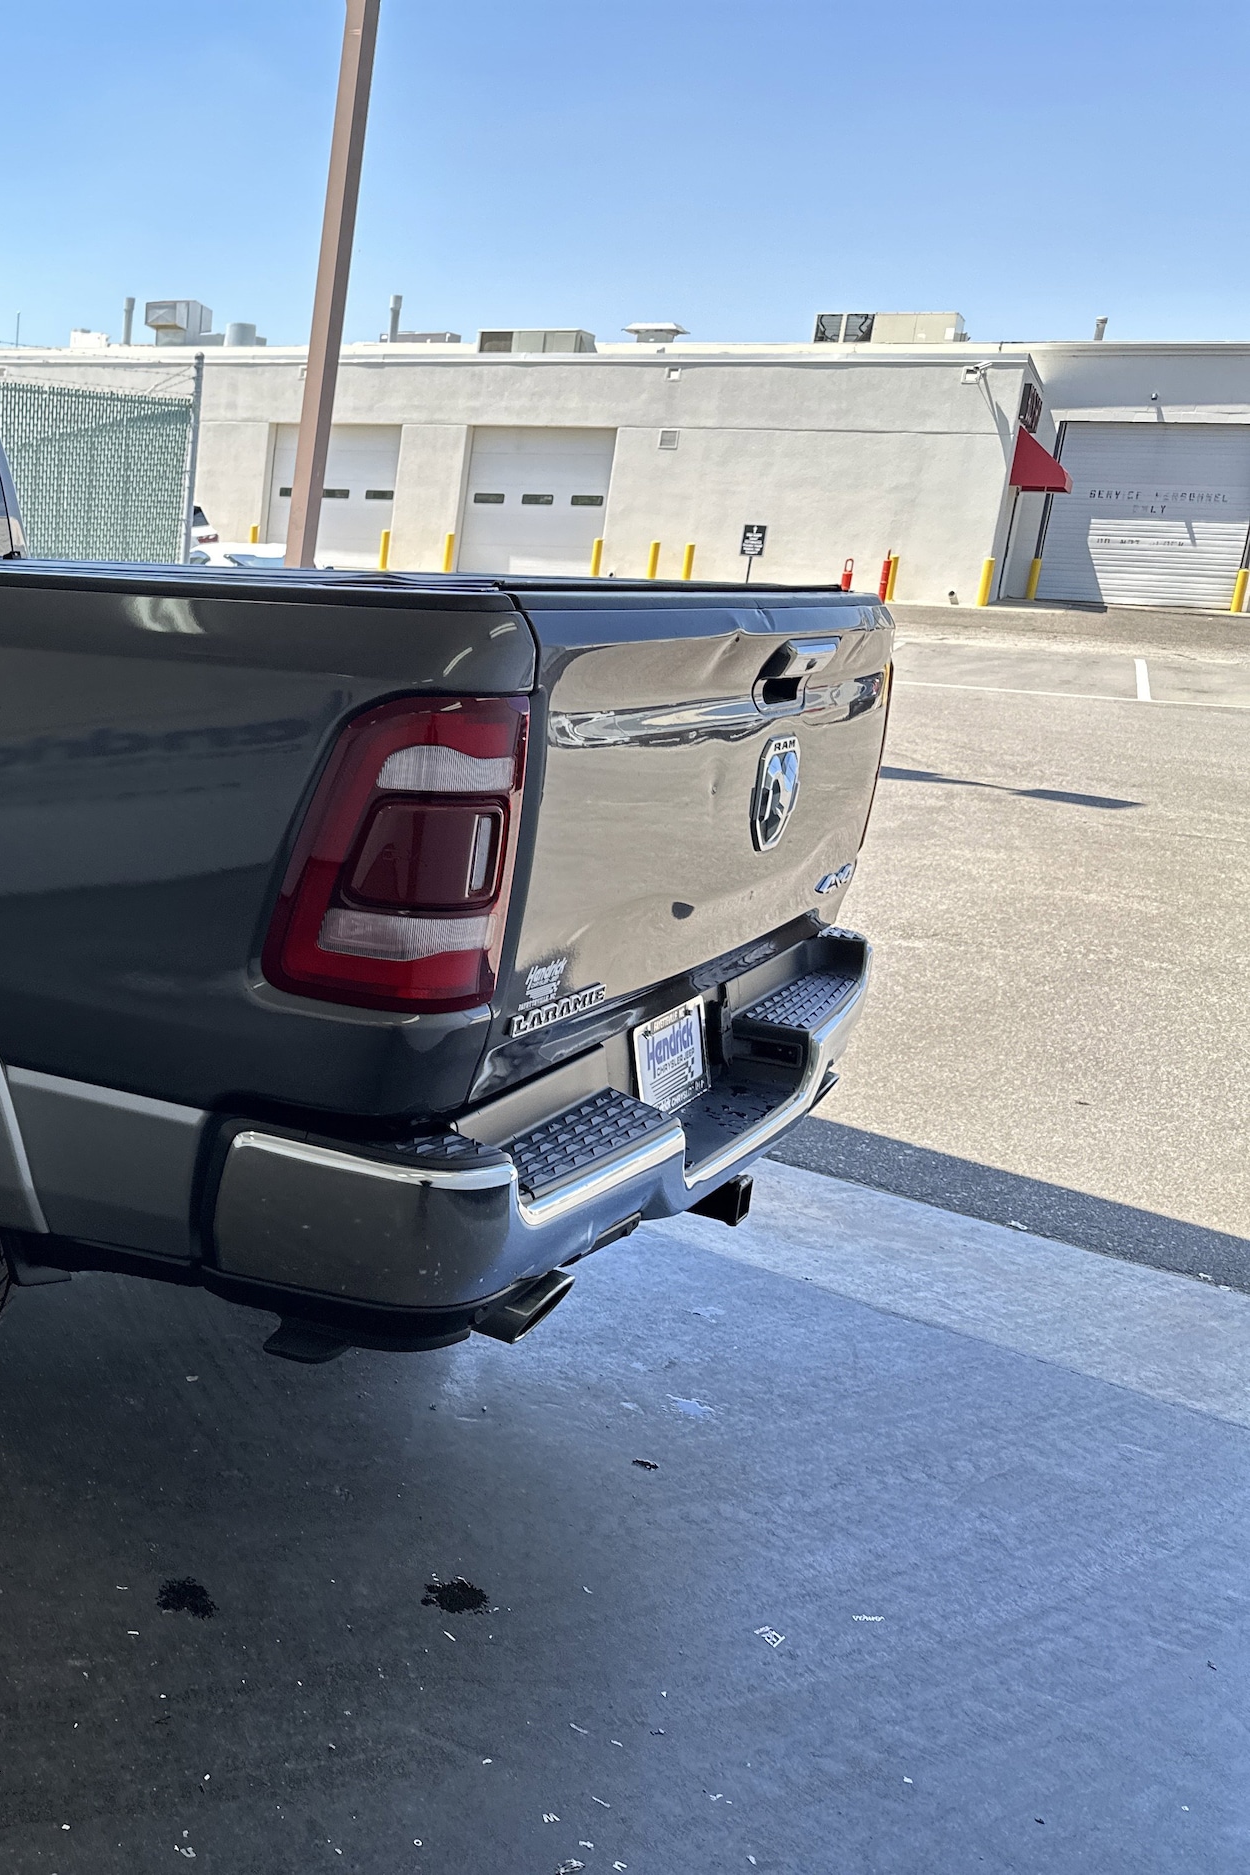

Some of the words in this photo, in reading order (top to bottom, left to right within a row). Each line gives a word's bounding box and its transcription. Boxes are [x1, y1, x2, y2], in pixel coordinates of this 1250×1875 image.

[773, 739, 796, 751] RAM
[525, 957, 567, 990] Hendrick
[510, 983, 606, 1038] LARAMIE
[646, 1018, 693, 1079] Hendrick
[657, 1055, 684, 1076] CHRYSLER
[683, 1048, 695, 1061] JEEP
